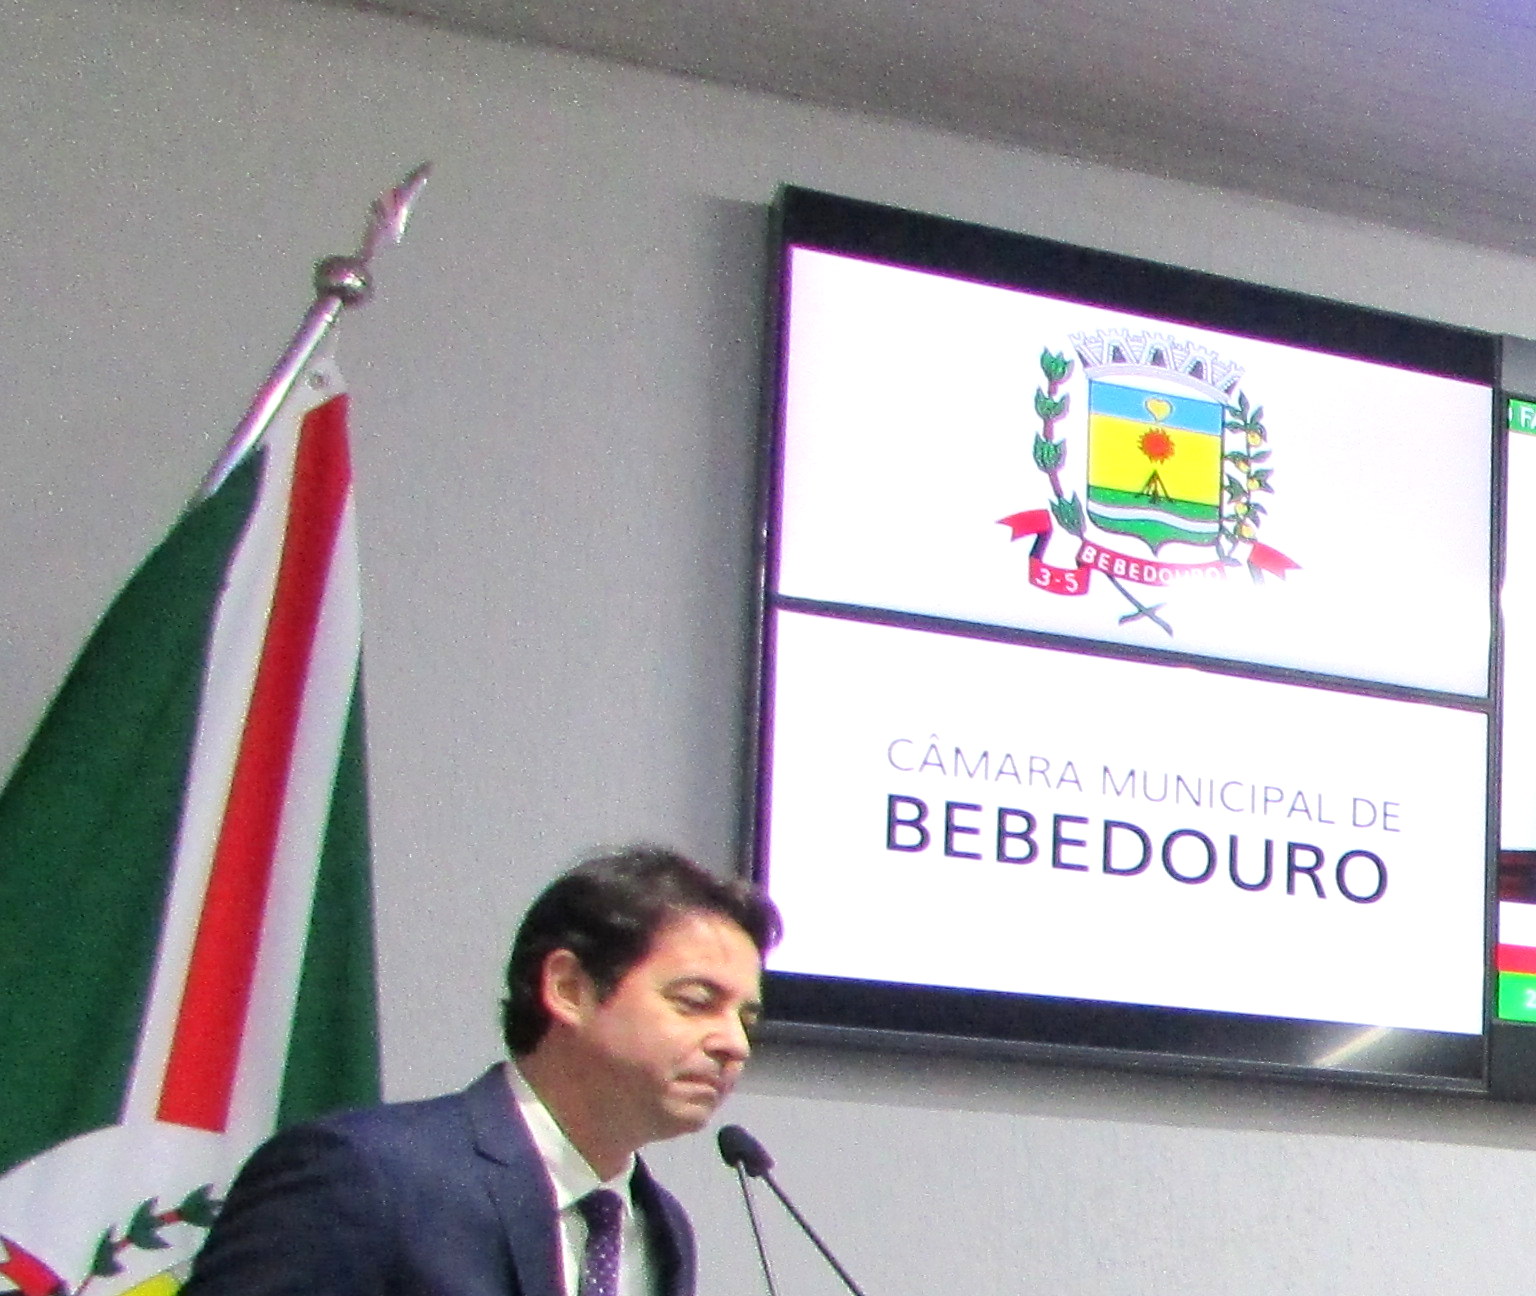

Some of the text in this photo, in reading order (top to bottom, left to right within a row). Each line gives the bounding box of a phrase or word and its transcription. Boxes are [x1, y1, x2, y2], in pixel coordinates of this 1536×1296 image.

[886, 733, 1401, 833] CÂMARA MUNICIPAL DE
[885, 794, 1389, 905] BEBEDOURO
